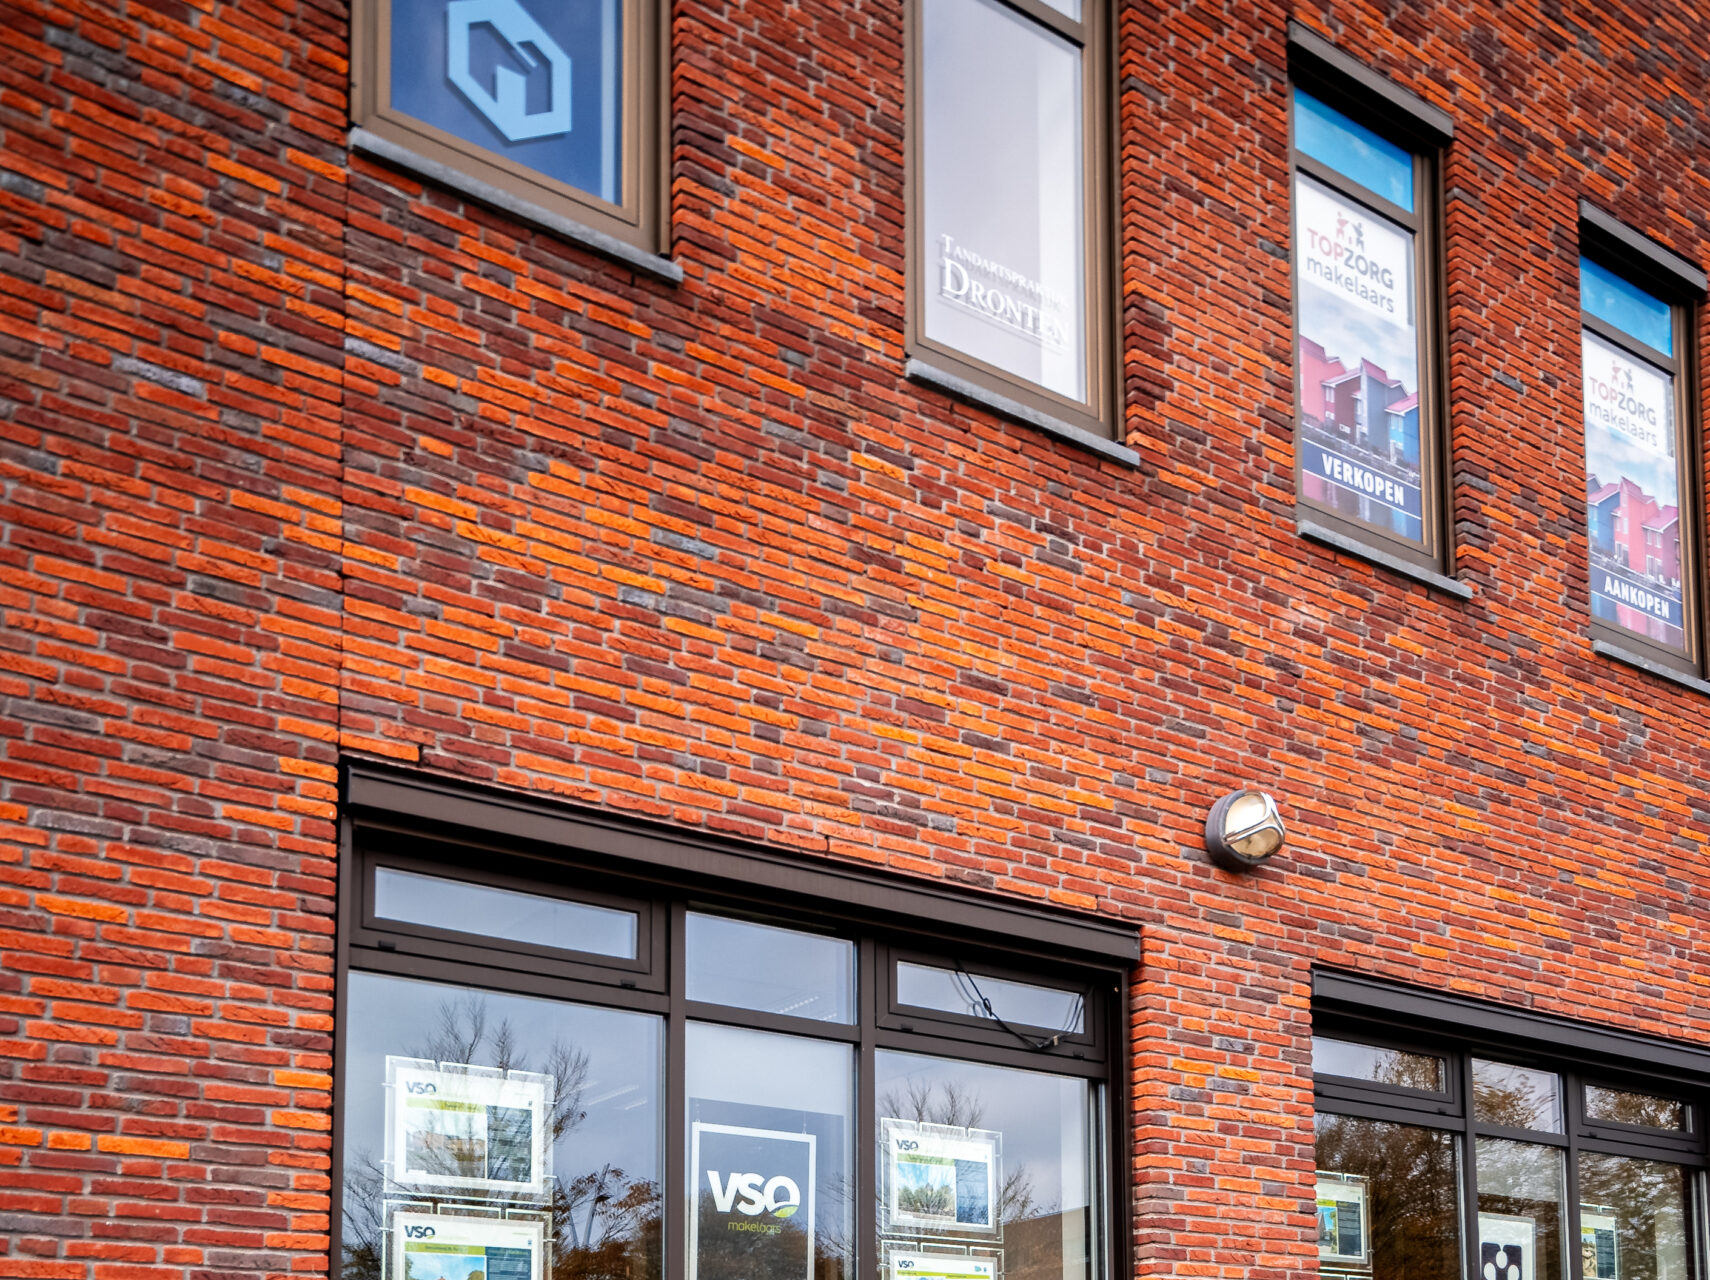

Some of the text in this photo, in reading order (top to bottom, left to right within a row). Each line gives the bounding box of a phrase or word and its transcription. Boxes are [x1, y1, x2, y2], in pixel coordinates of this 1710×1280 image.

[1306, 227, 1393, 290] TOPZORG
[1306, 256, 1394, 313] makelaars
[1588, 375, 1657, 426] TOPZORG
[1589, 401, 1658, 447] makelaars
[1321, 452, 1405, 506] VERKOPEN
[1604, 575, 1670, 618] AANKOPEN
[706, 1169, 801, 1218] VSO
[727, 1220, 782, 1234] makelaars
